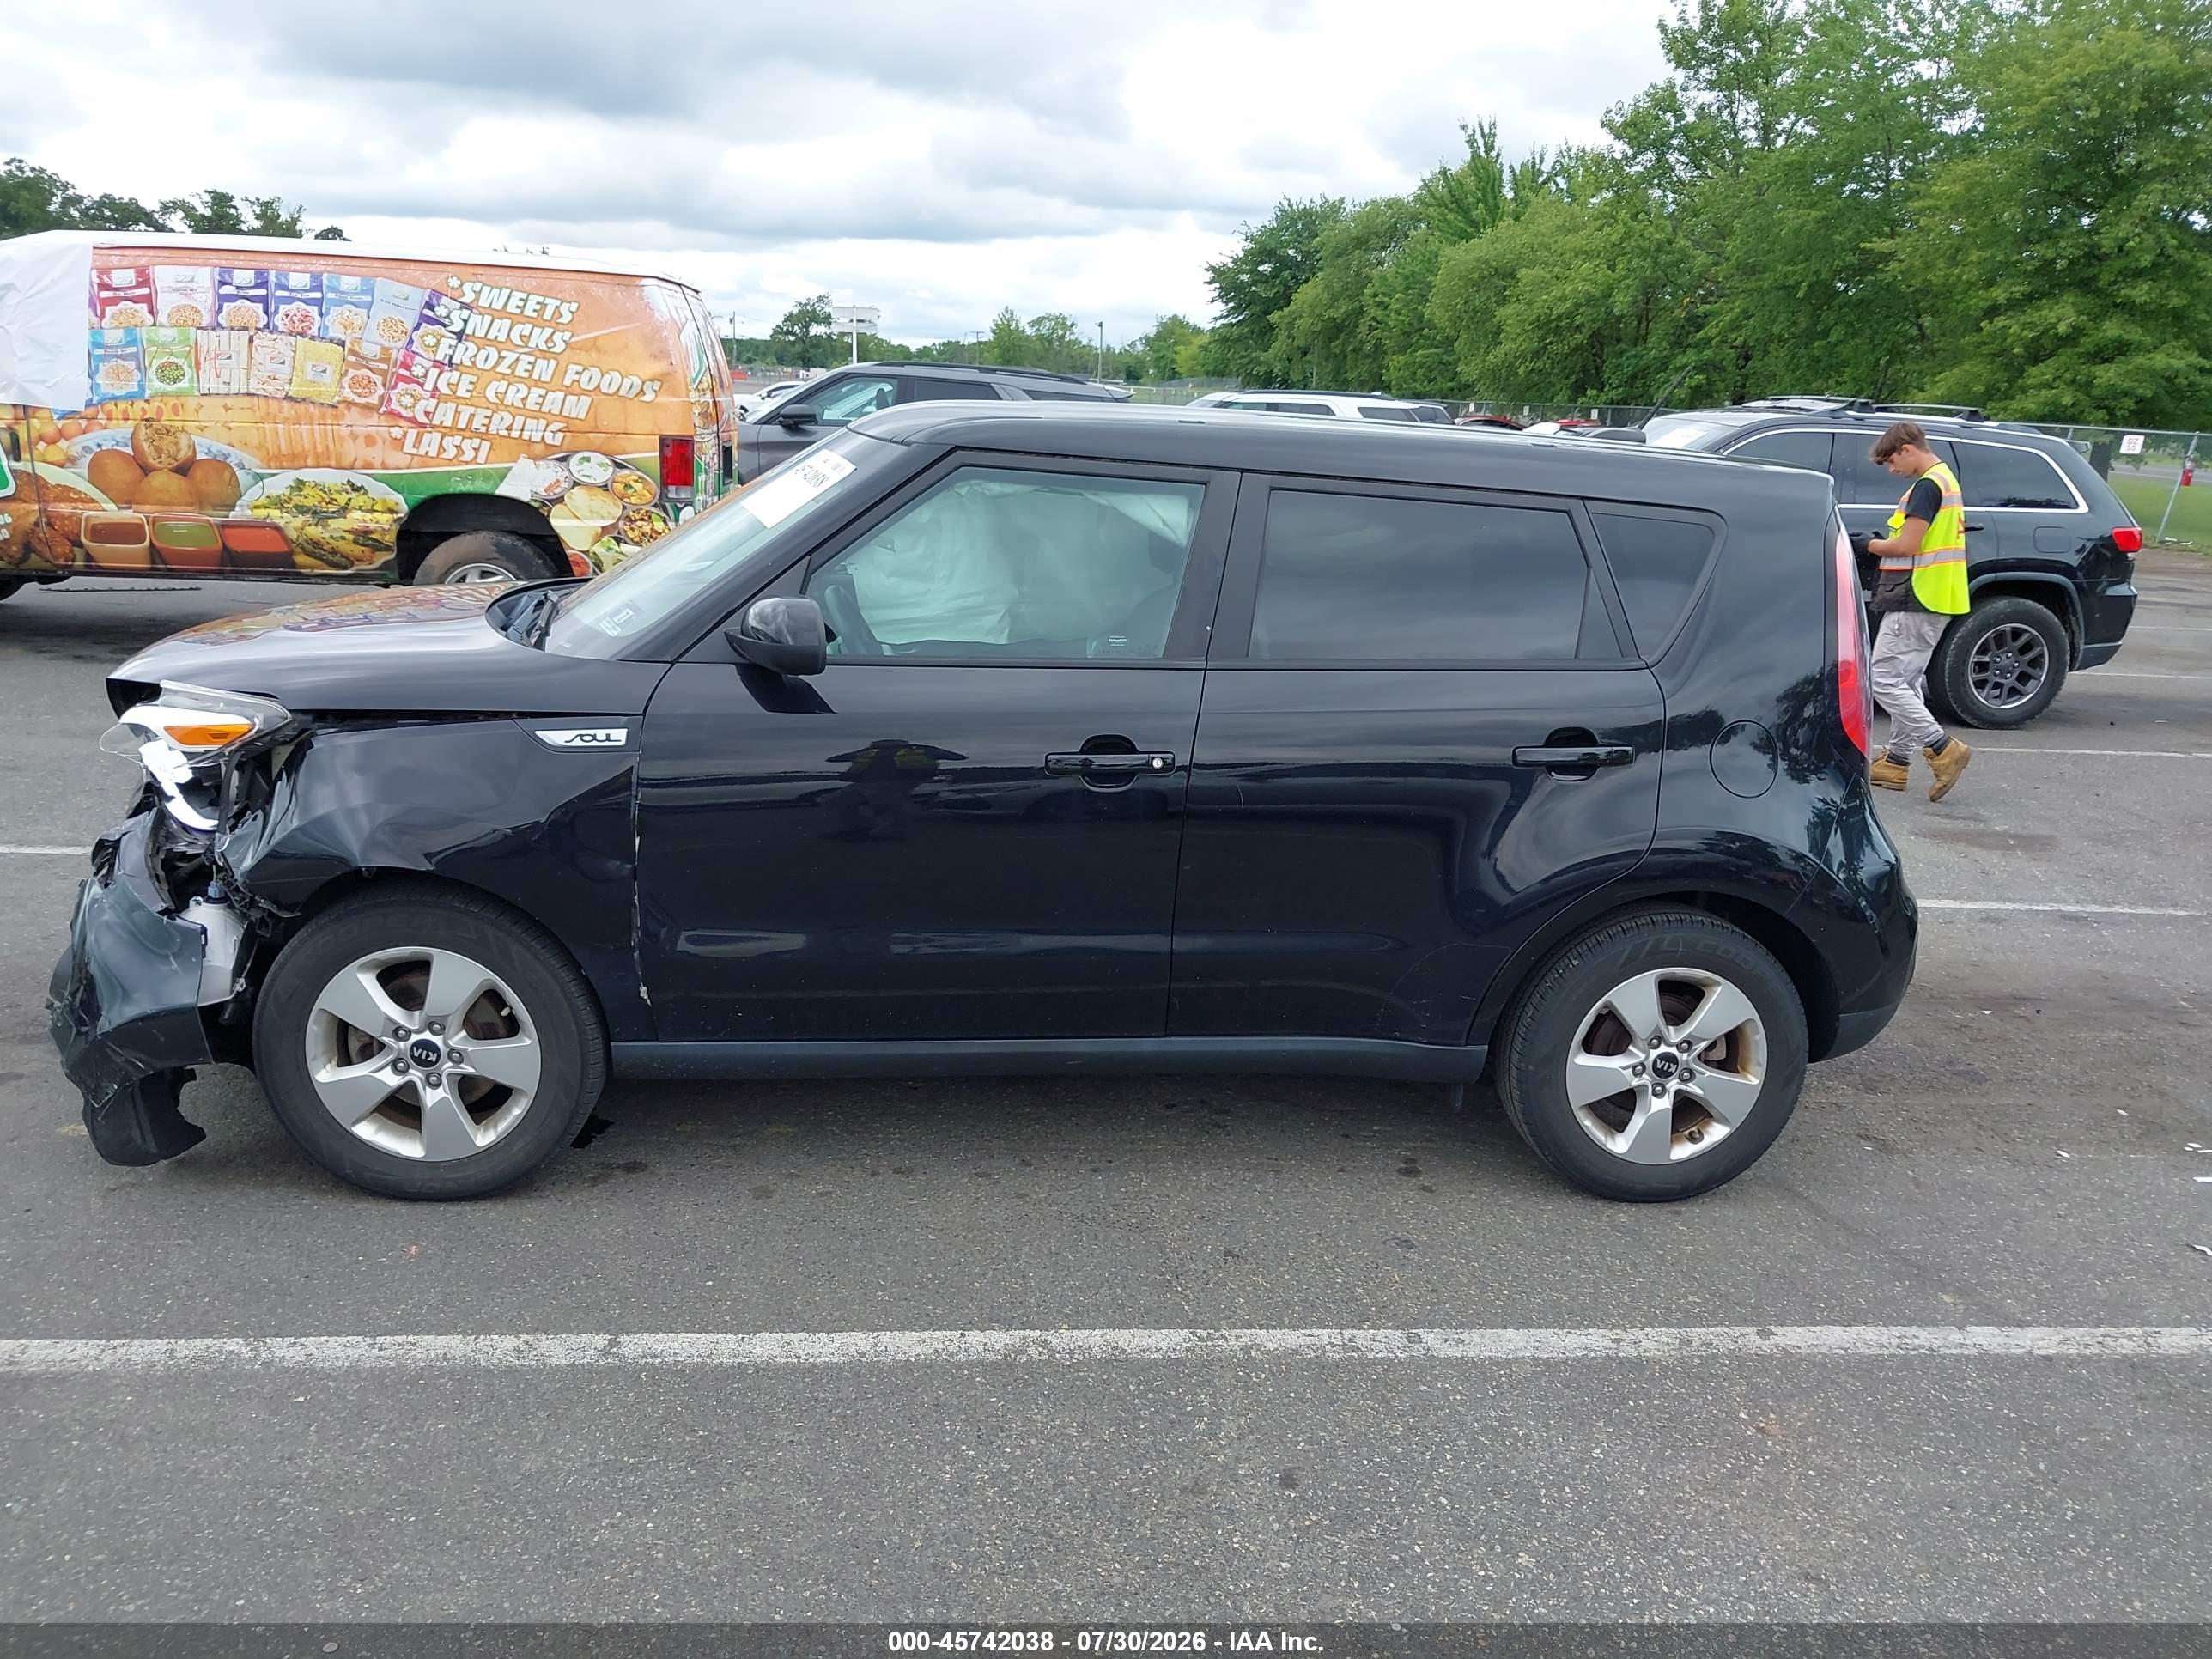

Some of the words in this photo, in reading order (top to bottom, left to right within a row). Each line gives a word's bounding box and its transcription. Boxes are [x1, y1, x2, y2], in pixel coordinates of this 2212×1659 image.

[459, 281, 580, 325] SWEETS
[446, 306, 574, 354] SNACKS
[434, 336, 558, 383] FROZEN
[562, 363, 663, 403] FOODS
[423, 367, 478, 399] ICE
[483, 379, 593, 421] CREAM
[413, 398, 568, 447] CATERING
[402, 428, 492, 465] LASSI
[413, 1047, 438, 1062] KIA
[1656, 1058, 1677, 1073] KIA
